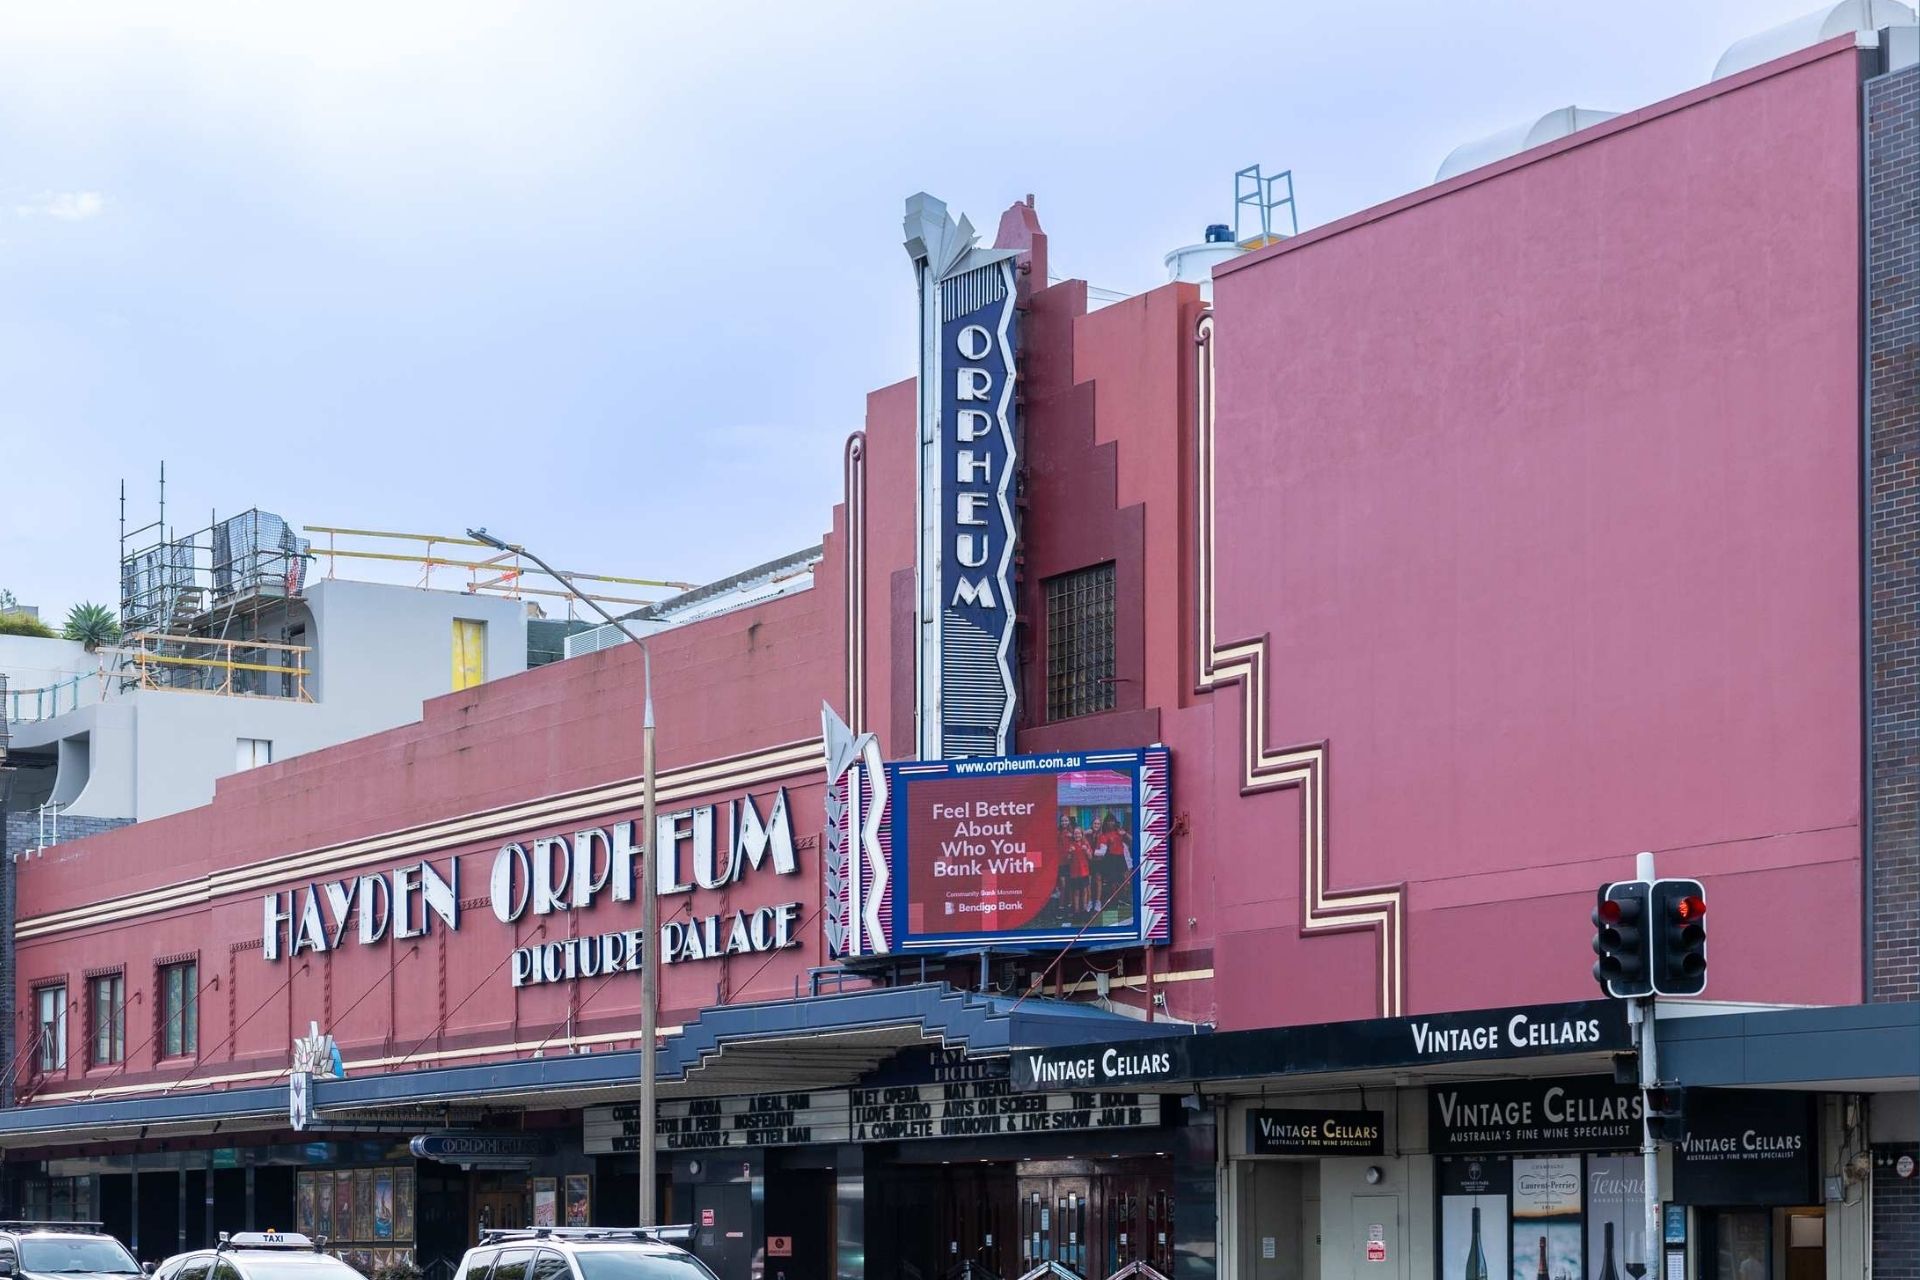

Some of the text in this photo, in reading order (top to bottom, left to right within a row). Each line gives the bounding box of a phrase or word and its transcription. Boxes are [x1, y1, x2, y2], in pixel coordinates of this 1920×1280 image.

[951, 324, 996, 609] ORPHEUM
[956, 757, 1080, 774] www.orpheum.com.au
[933, 801, 1034, 819] Feel Better
[954, 821, 1013, 837] About
[942, 840, 1026, 857] Who You
[263, 786, 798, 960] HAYDEN ORPHEUM
[934, 859, 1034, 878] Bank With
[958, 901, 1023, 914] Bendigo Bank
[512, 902, 803, 988] PICTURE PALACE
[1411, 1014, 1600, 1054] VINTAGE CELLARS
[1029, 1049, 1170, 1082] VINTAGE CELLARS
[852, 1089, 880, 1106] MET
[978, 1098, 997, 1115] ON
[1000, 1095, 1047, 1114] SCREEN
[1071, 1092, 1096, 1109] THE
[1437, 1087, 1642, 1127] VINTAGE CELLARS
[734, 1111, 794, 1130] NOSFERATU
[858, 1123, 866, 1140] A
[871, 1120, 933, 1139] COMPLETE
[941, 1115, 1000, 1135] UNKNOWN
[1007, 1114, 1016, 1132] &
[1022, 1112, 1050, 1131] LIVE
[1052, 1109, 1090, 1130] SHOW
[1097, 1108, 1124, 1126] JAN
[1260, 1118, 1378, 1138] VINTAGE CELLARS
[667, 1133, 720, 1149] GLADIATOR
[722, 1132, 730, 1147] 2
[1340, 1139, 1371, 1147] SPECIALIST
[1450, 1125, 1630, 1142] AUSTRALIA'S FINE WINE SPECIALIST
[1681, 1130, 1801, 1152] VINTAGE CELLARS
[1686, 1153, 1724, 1161] AUSTRALIA'S
[1742, 1152, 1759, 1160] WINE
[1761, 1151, 1794, 1159] SPECIALIST
[263, 1234, 284, 1243] TAXI
